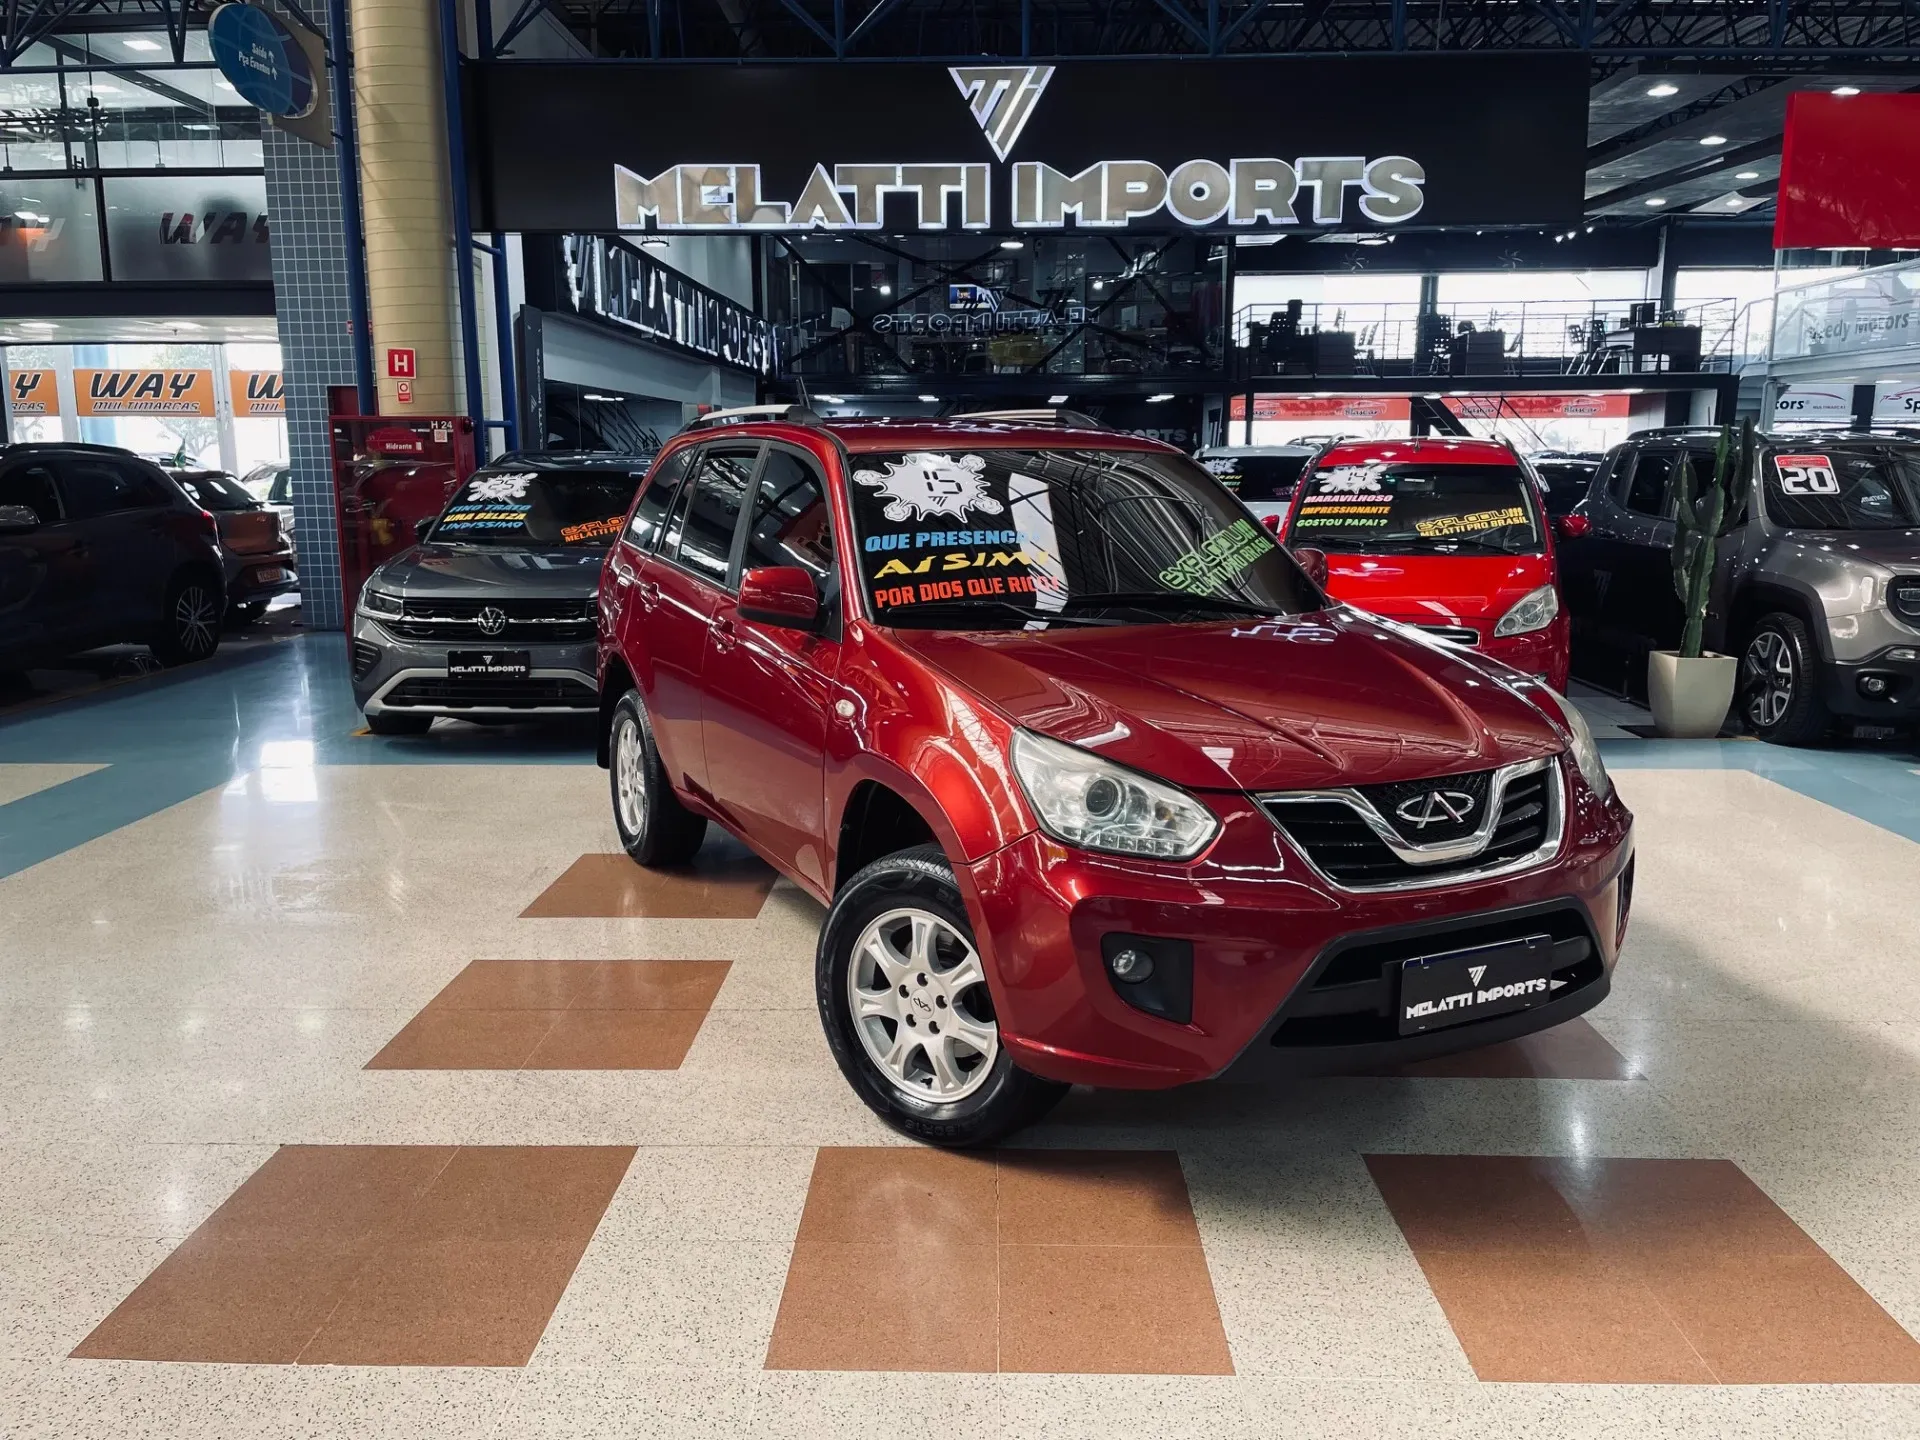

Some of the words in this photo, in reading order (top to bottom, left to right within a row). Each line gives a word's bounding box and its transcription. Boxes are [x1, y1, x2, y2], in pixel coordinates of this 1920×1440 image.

[614, 162, 991, 229] MELATTI
[1012, 155, 1426, 227] IMPORTS
[394, 354, 408, 372] H
[90, 372, 196, 399] WAY
[441, 421, 453, 429] 24
[488, 478, 517, 491] 25
[923, 468, 963, 495] 15
[1348, 472, 1367, 481] 14
[1784, 467, 1836, 492] 20
[1303, 494, 1394, 504] MARAVILHOSO
[443, 513, 475, 523] UMA
[474, 512, 528, 520] BELEZA
[1300, 506, 1392, 515] IMPRESSIONANTE
[1296, 518, 1343, 528] GOSTOU
[1420, 524, 1466, 538] MELATTI
[1466, 520, 1490, 532] PRO
[1490, 515, 1530, 527] BRASIL
[564, 527, 609, 543] MELATTI
[865, 533, 911, 553] QUE
[875, 586, 916, 609] POR
[918, 580, 964, 602] DIOS
[967, 575, 1006, 596] QUE
[450, 665, 486, 673] MELATTI
[487, 665, 527, 673] IMPORTS
[1405, 992, 1474, 1020] MELATTI
[1476, 977, 1548, 1005] IMPORTS
